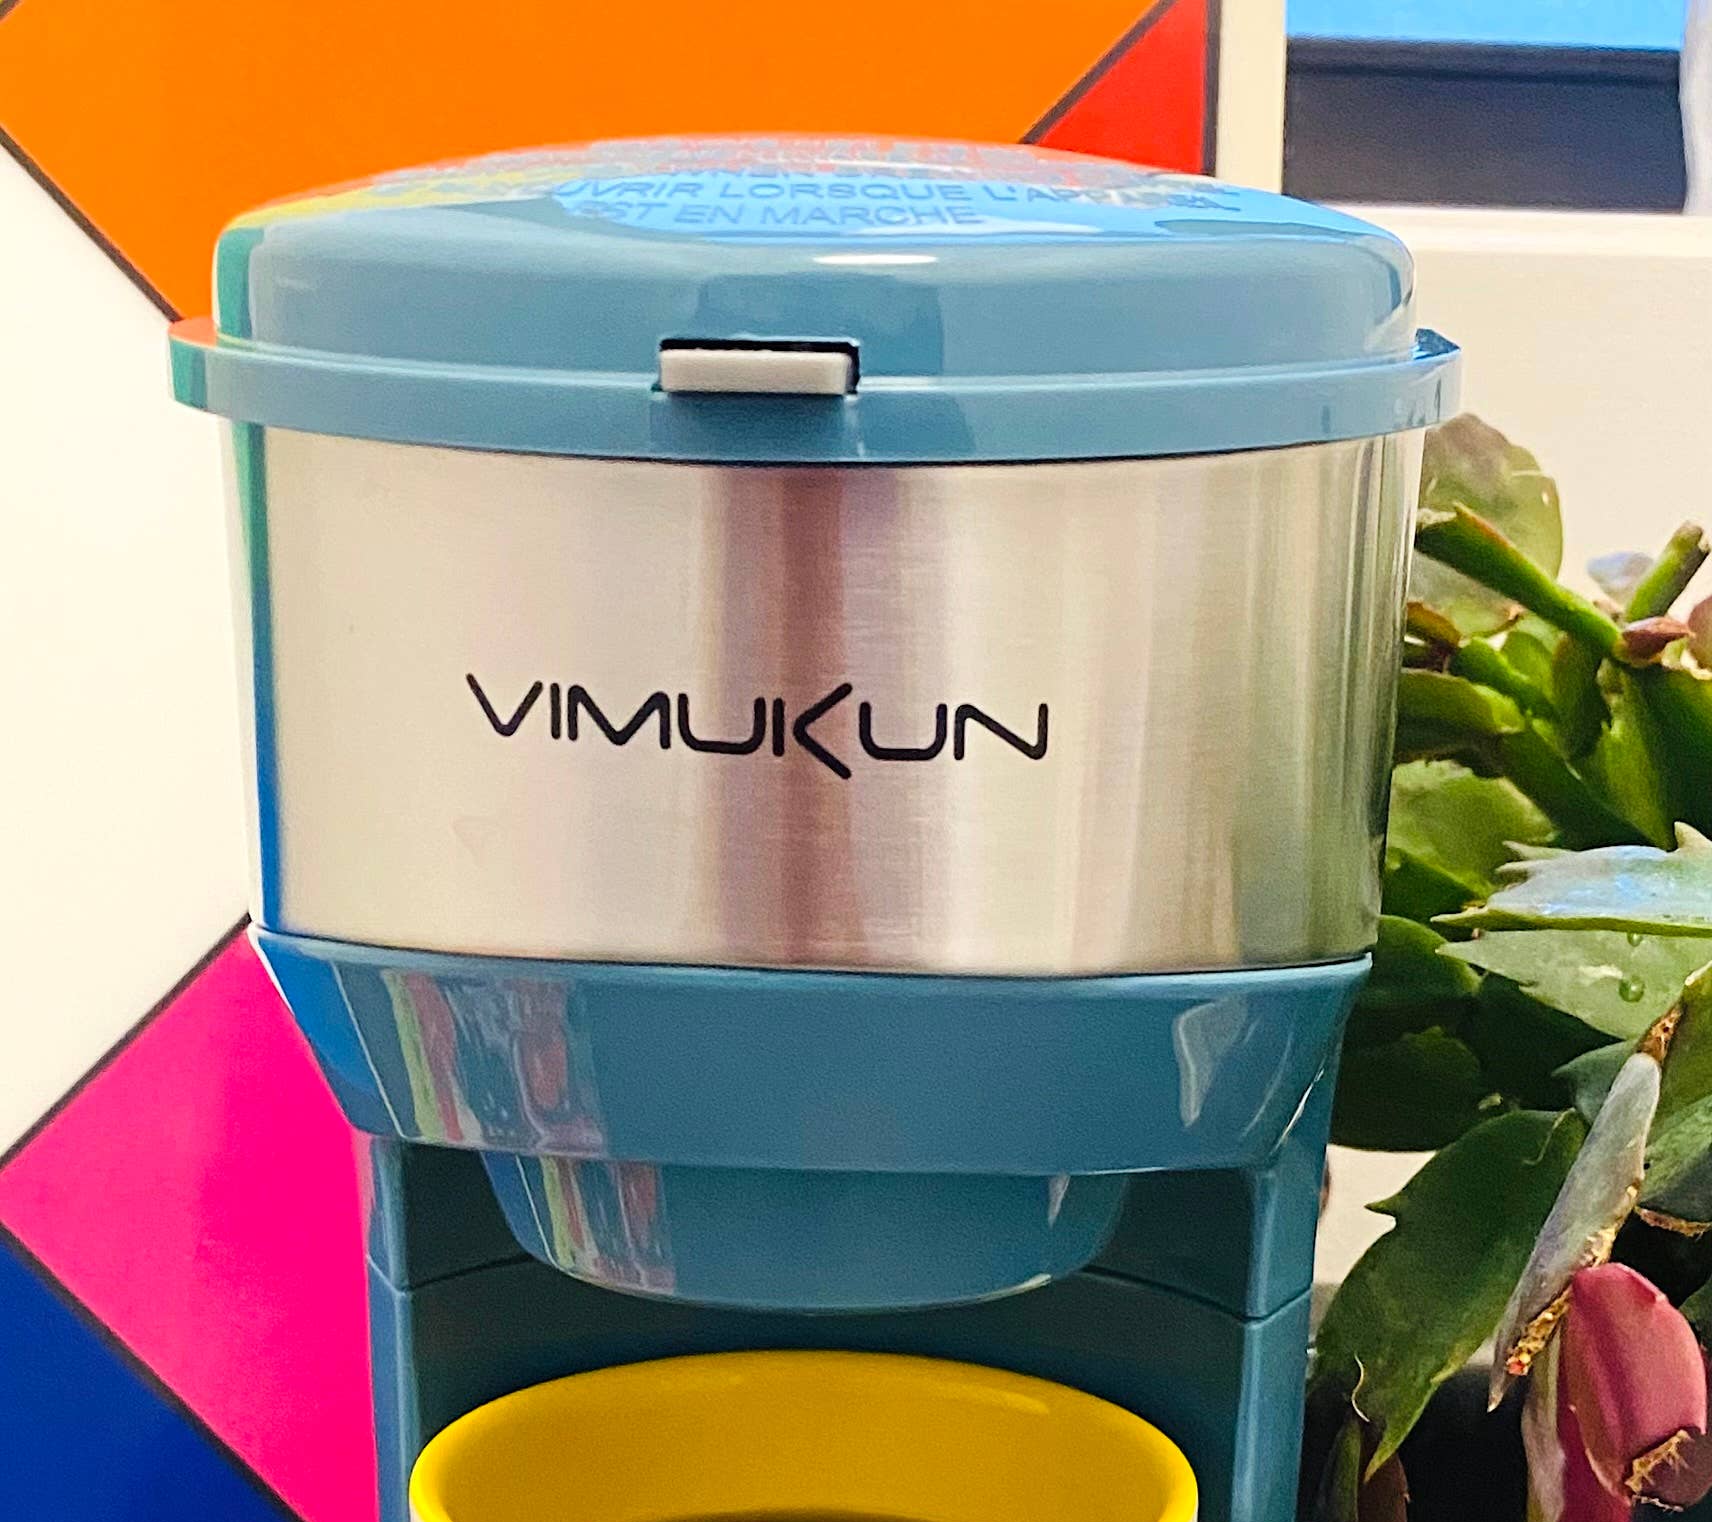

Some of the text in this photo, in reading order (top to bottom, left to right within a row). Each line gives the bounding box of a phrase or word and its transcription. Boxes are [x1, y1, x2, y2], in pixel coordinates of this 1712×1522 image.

[719, 181, 973, 201] LORSQUE
[673, 203, 746, 224] EN
[759, 205, 986, 226] MARCHE
[466, 673, 1049, 781] VIMUKUN
